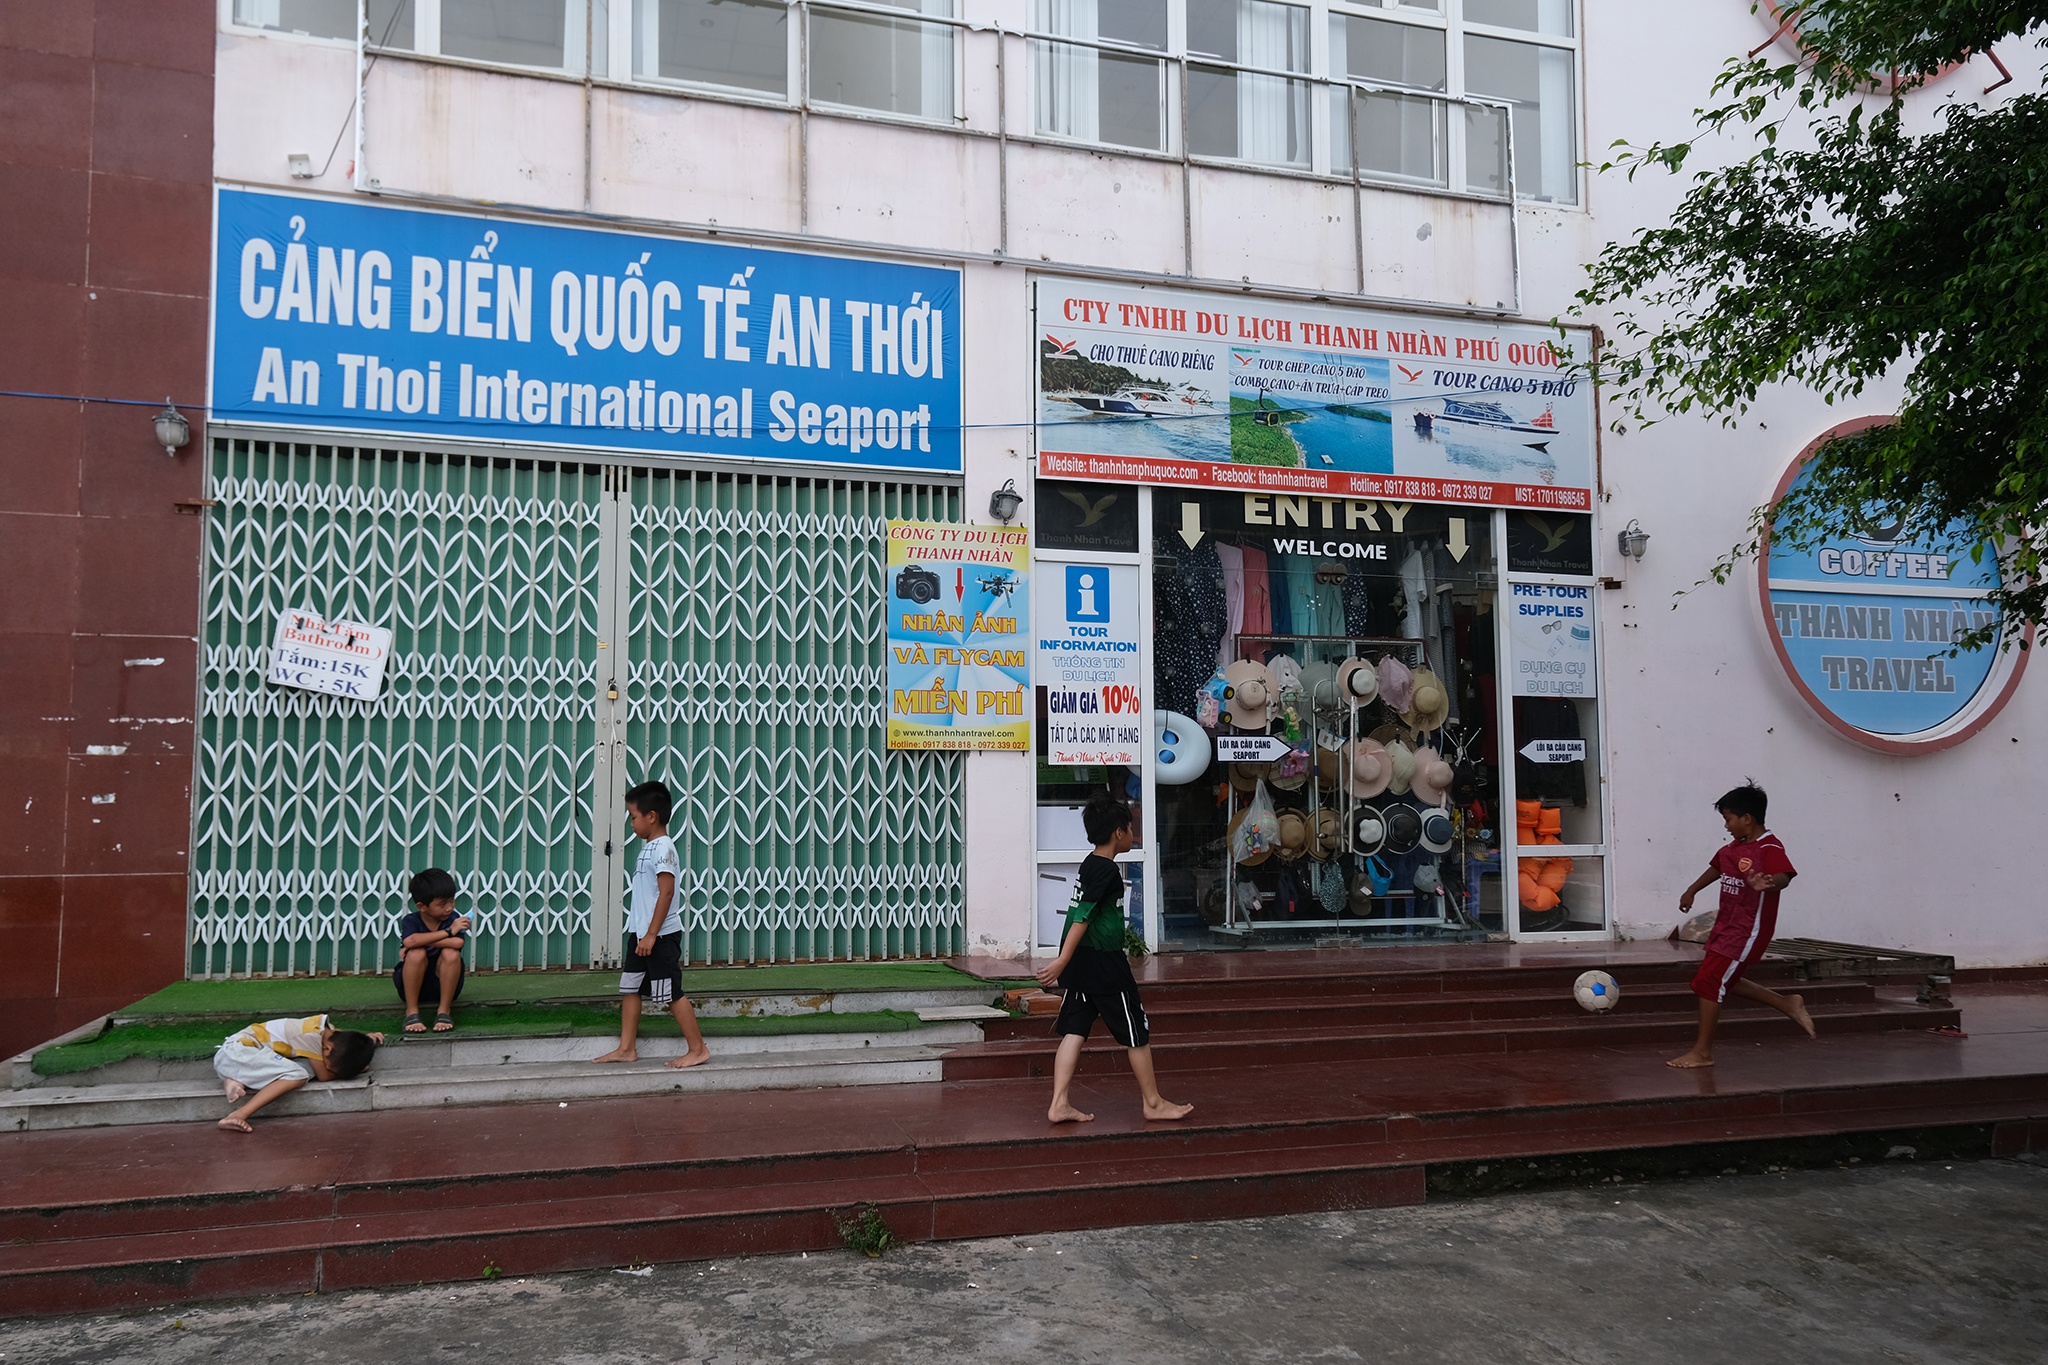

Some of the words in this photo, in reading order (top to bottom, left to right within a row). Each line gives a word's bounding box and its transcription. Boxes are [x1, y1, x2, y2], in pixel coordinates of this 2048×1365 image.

[239, 215, 392, 330] CẢNG
[410, 230, 533, 343] BIỂN
[550, 252, 681, 356] QUỐC
[698, 266, 755, 362] TẾ
[766, 293, 830, 369] AN
[845, 292, 943, 379] THỚI
[1063, 298, 1110, 324] CTY
[1119, 303, 1187, 332] TNHH
[1196, 311, 1229, 336] DU
[1237, 315, 1292, 343] LỊCH
[1300, 322, 1379, 351] THANH
[1386, 329, 1447, 357] NHÀN
[1455, 336, 1500, 362] PHÚ
[1090, 343, 1114, 362] CHO
[1117, 344, 1148, 365] THUÊ
[1149, 349, 1180, 368] CANO
[1181, 349, 1215, 371] RIÊNG
[1258, 358, 1284, 371] TOUR
[1284, 360, 1310, 374] GHÉP
[1311, 363, 1336, 376] CANO
[1337, 366, 1344, 377] 5
[1234, 375, 1268, 389] COMBO
[1365, 386, 1389, 399] TREO
[1432, 369, 1477, 390] TOUR
[1480, 374, 1523, 393] CANO
[1526, 378, 1538, 395] 5
[252, 347, 320, 406] An
[337, 353, 441, 415] Thoi
[459, 363, 752, 438] International
[769, 390, 931, 453] Seaport
[1046, 455, 1087, 473] Wedsite:
[1089, 459, 1199, 481] thanhnhanphuquoc.com
[1212, 466, 1256, 485] Facebook:
[1258, 470, 1328, 489] thanhnhantravel
[1350, 477, 1382, 493] Hotline:
[1384, 479, 1404, 495] 0917
[1405, 481, 1420, 496] 838
[1421, 482, 1436, 497] 818
[1442, 483, 1462, 498] 0972
[1462, 484, 1477, 500] 339
[1478, 485, 1493, 501] 027
[1515, 487, 1535, 503] MST:
[1536, 489, 1585, 506] 17011968545
[1244, 494, 1414, 533] ENTRY
[890, 524, 934, 541] CÔNG
[940, 529, 961, 542] TY
[963, 531, 988, 543] DU
[991, 532, 1029, 548] LỊCH
[1041, 532, 1072, 543] Thanh
[906, 546, 964, 561] THANH
[967, 547, 1014, 563] NHÀN
[1273, 538, 1388, 560] WELCOME
[1818, 547, 1949, 580] COFFEE
[1513, 584, 1588, 599] PRE-TOUR
[901, 609, 964, 636] NHẬN
[970, 611, 1016, 634] ẢNH
[1518, 603, 1584, 618] SUPPLIES
[1773, 602, 1893, 641] THANH
[1069, 626, 1108, 638] TOUR
[893, 642, 929, 665] VÀ
[933, 648, 1025, 667] FLYCAM
[1040, 639, 1137, 652] INFORMATION
[1052, 654, 1102, 668] THÔNG
[1103, 658, 1125, 669] TIN
[1519, 660, 1563, 677] DỤNG
[1564, 661, 1586, 679] CỤ
[275, 667, 312, 686] WC
[331, 679, 362, 695] 5K
[1062, 670, 1083, 681] DU
[1084, 671, 1116, 683] LỊCH
[1821, 655, 1956, 693] TRAVEL
[893, 676, 968, 716] MIỄN
[976, 683, 1025, 715] PHÍ
[1050, 685, 1077, 714] GIẢM
[1079, 688, 1098, 714] GIÁ
[1102, 685, 1140, 714] 10%
[1526, 680, 1549, 693] DU
[1550, 681, 1584, 697] LỊCH
[890, 740, 920, 748] Hotline:
[922, 740, 941, 749] 0917
[942, 740, 956, 749] 838
[957, 740, 971, 749] 818
[978, 741, 996, 749] 0972
[997, 741, 1011, 749] 339
[1012, 741, 1026, 749] 027
[903, 729, 1015, 738] www.thanhnhantravel.com
[1050, 721, 1065, 743] TẤT
[1067, 722, 1078, 743] CẢ
[1080, 723, 1096, 744] CÁC
[1099, 724, 1115, 747] MẶT
[1118, 724, 1139, 744] HÀNG
[1233, 751, 1260, 760] SEAPORT
[1548, 753, 1572, 762] SEAPORT
